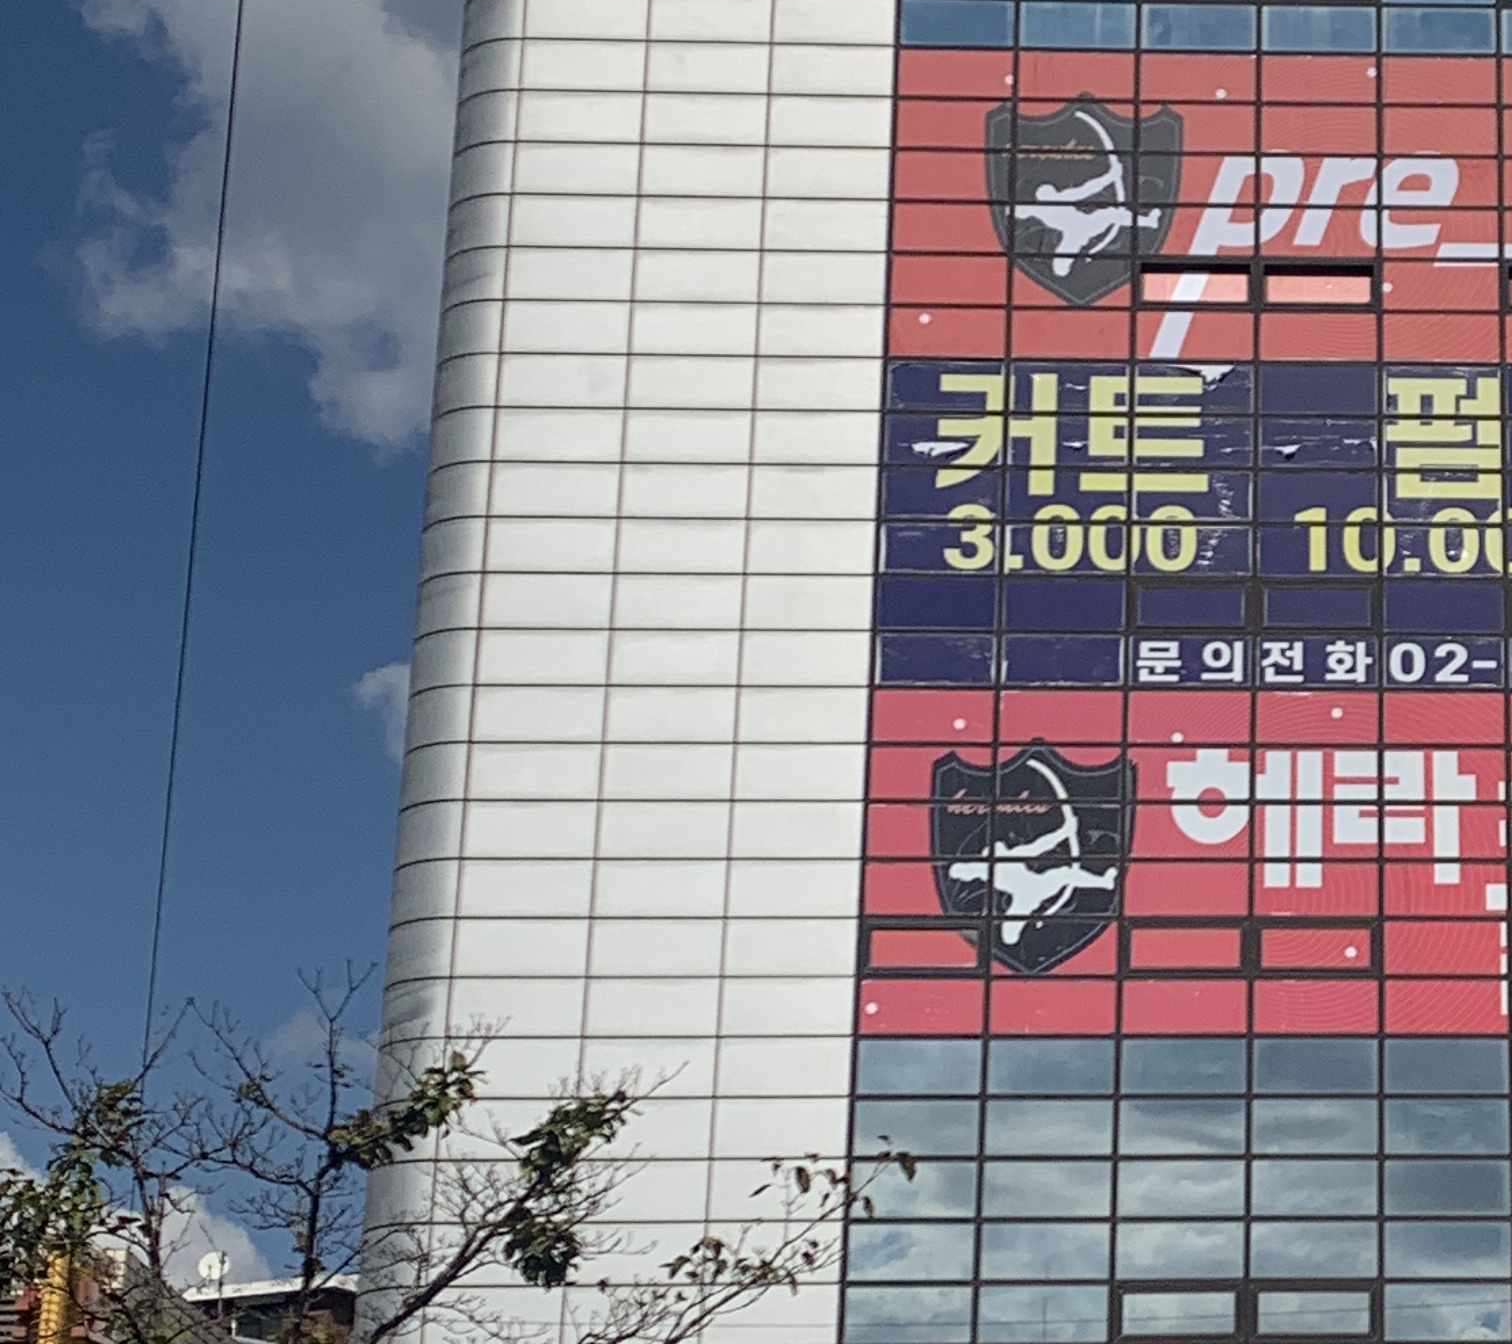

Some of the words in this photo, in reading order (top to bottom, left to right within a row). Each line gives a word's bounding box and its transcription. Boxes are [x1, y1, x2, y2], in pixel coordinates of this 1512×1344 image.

[935, 373, 1209, 496] 커트
[1386, 377, 1500, 499] 펌
[943, 505, 1198, 573] 3.000
